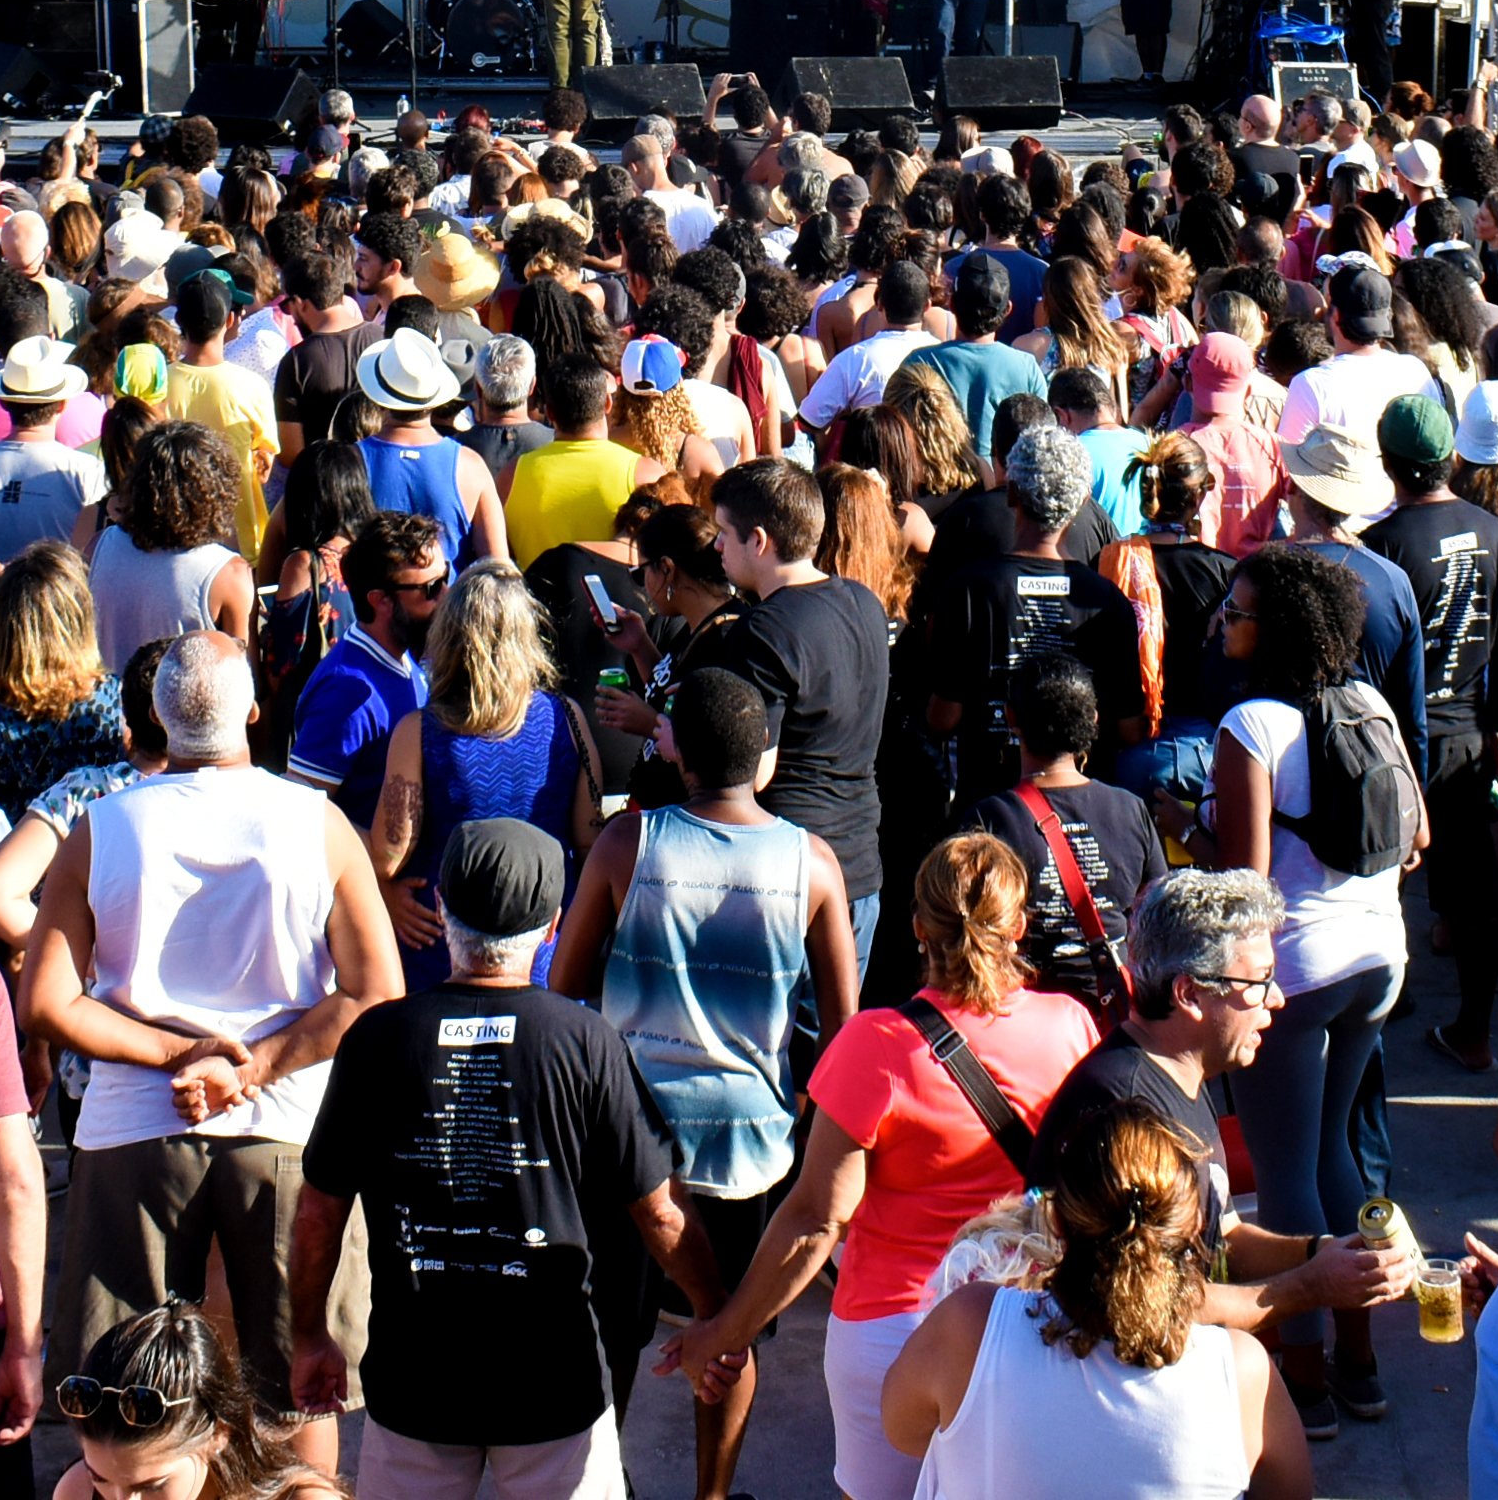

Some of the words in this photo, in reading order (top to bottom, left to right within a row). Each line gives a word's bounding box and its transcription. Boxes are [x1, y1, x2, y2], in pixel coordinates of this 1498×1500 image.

[1020, 579, 1069, 592] CASTING
[682, 880, 715, 890] OUSADO
[731, 884, 765, 896] OUSADO
[444, 1024, 511, 1038] CASTING
